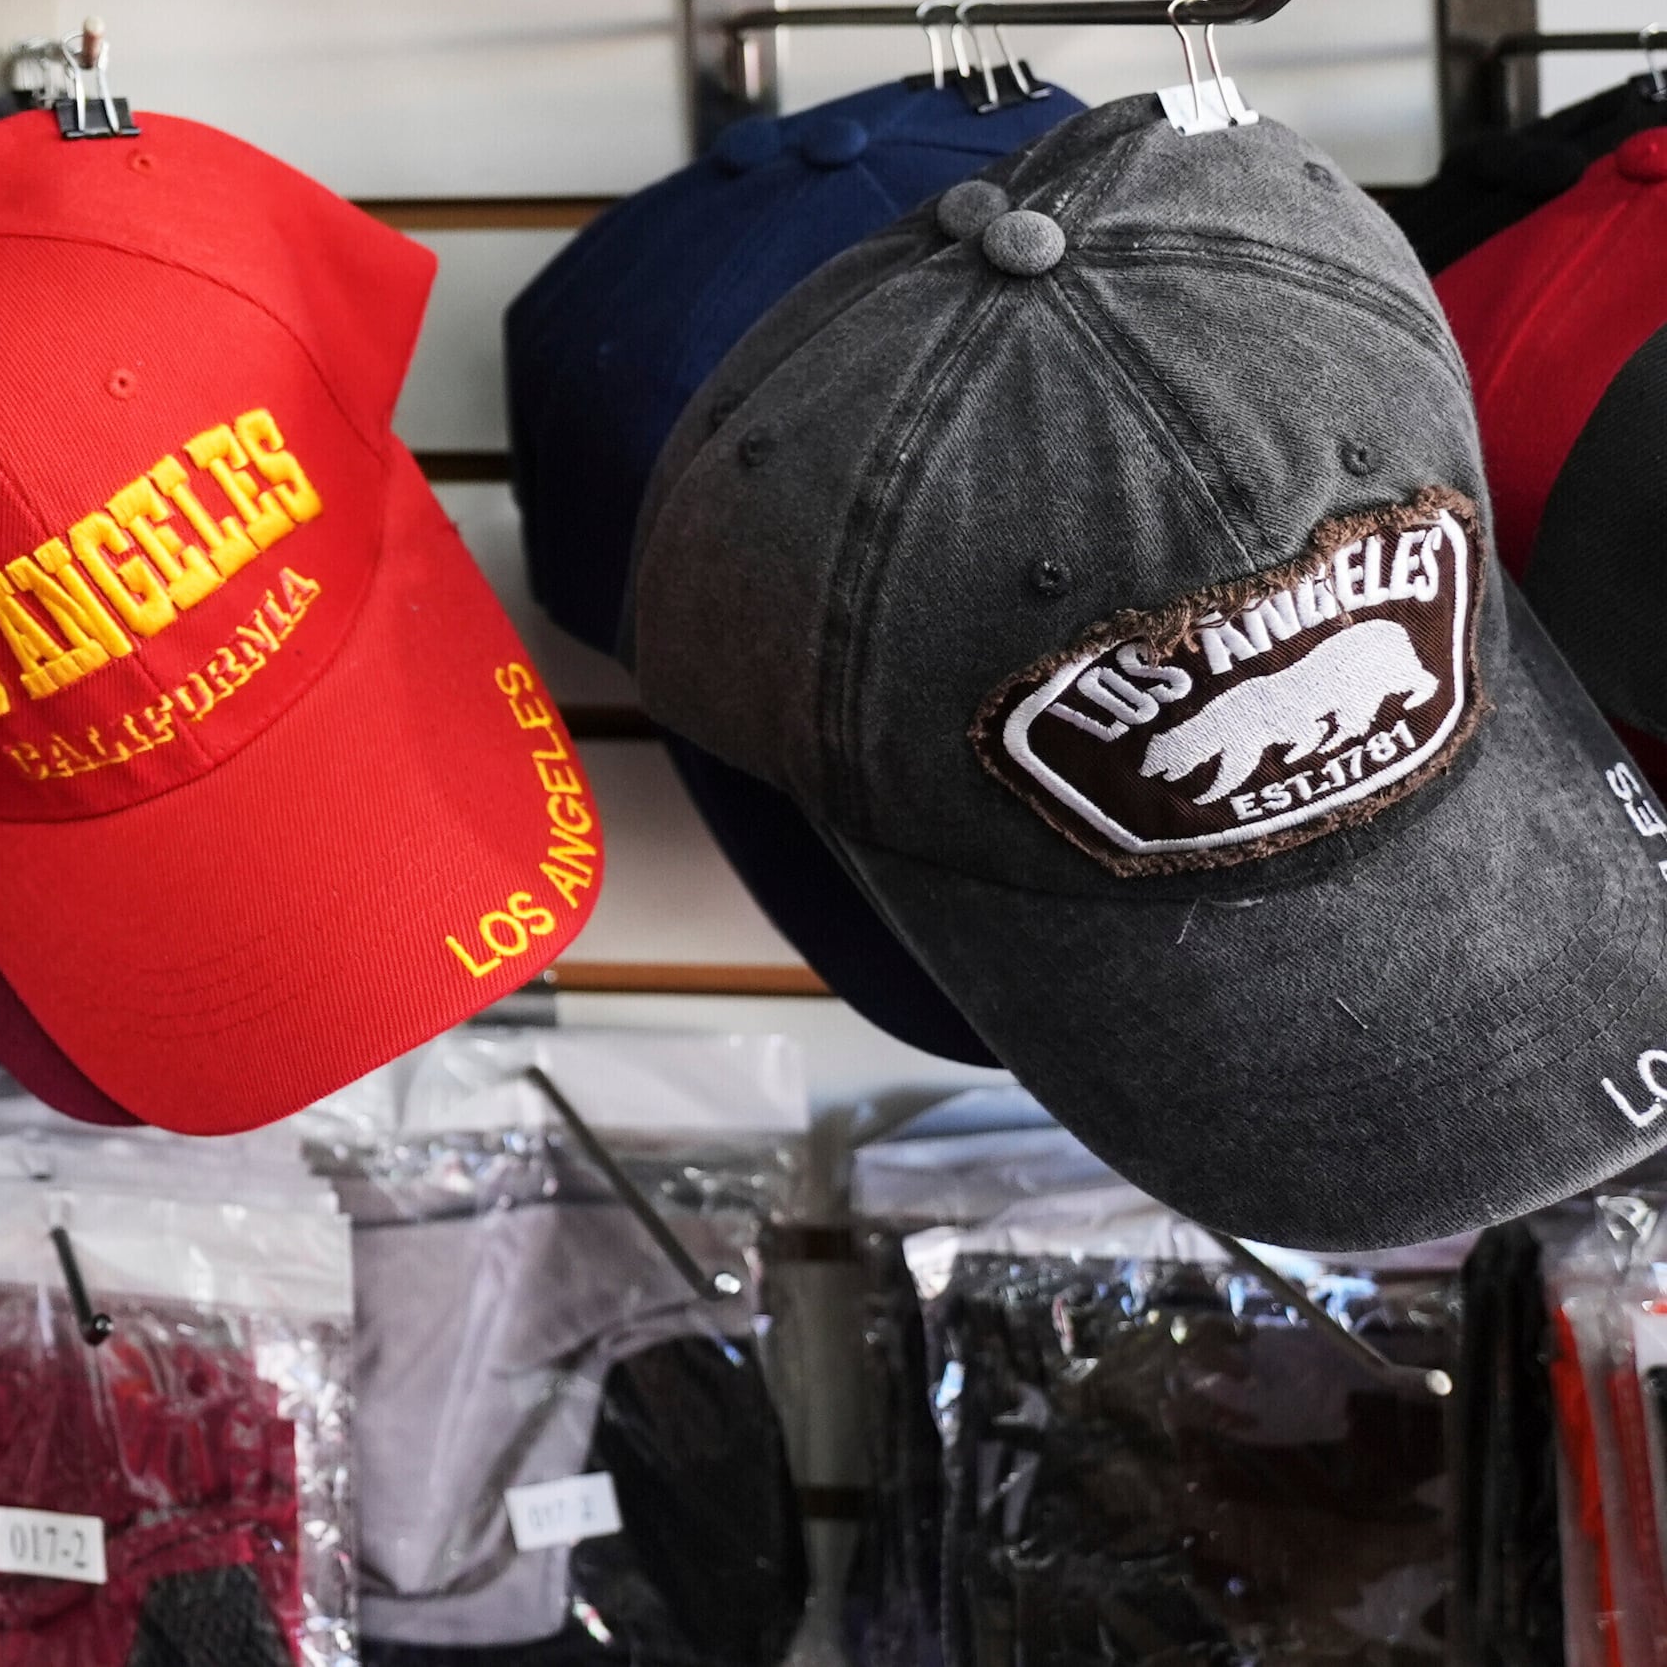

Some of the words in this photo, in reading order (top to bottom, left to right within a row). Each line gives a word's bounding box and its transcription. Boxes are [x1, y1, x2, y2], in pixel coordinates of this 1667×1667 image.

[3, 566, 322, 782] CALIFORNIA
[1048, 641, 1194, 743] LOS
[1194, 525, 1443, 676] ANGELES
[494, 660, 597, 908] ANGELES
[445, 890, 556, 979] LOS
[8, 1521, 88, 1569] 017-2
